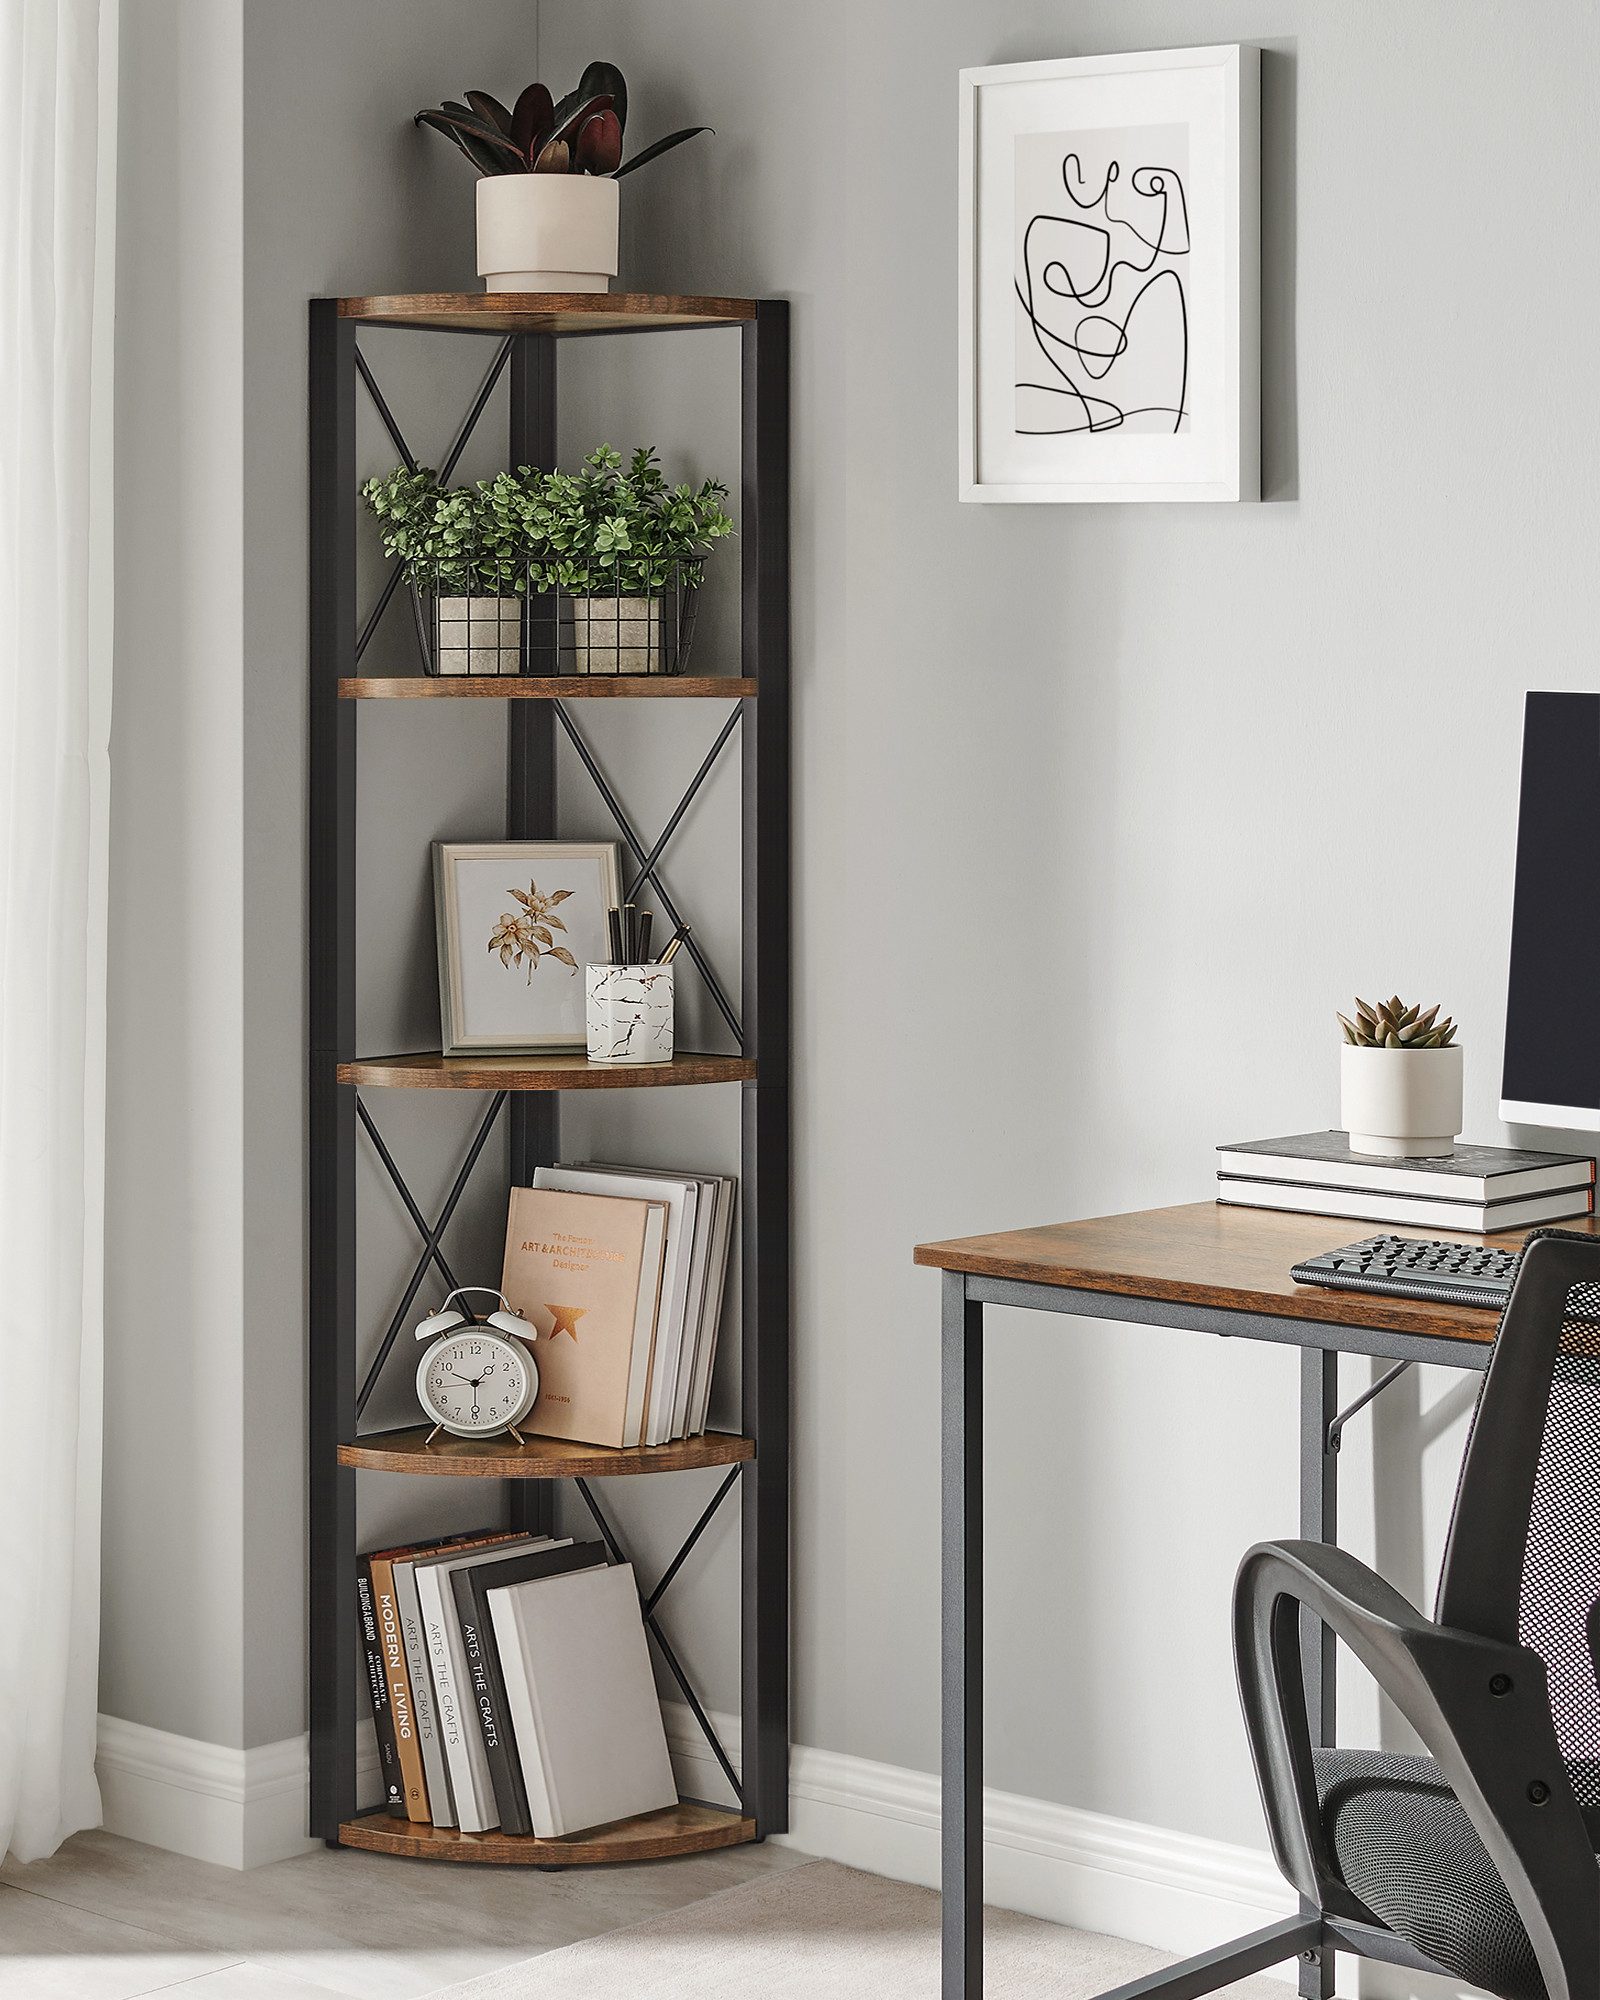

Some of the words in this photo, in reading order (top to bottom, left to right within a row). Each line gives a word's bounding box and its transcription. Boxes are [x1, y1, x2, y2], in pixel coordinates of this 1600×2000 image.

[521, 1242, 539, 1252] ART
[454, 1351, 463, 1359] 11
[471, 1346, 482, 1355] 12
[492, 1351, 496, 1359] 1
[442, 1362, 453, 1371] 10
[503, 1363, 510, 1371] 2
[436, 1378, 443, 1388] 9
[509, 1379, 516, 1387] 3
[441, 1395, 448, 1404] 8
[455, 1408, 461, 1416] 7
[490, 1408, 497, 1416] 5
[503, 1396, 509, 1404] 4
[357, 1578, 371, 1610] BUILDING
[363, 1616, 376, 1641] BRAND
[405, 1617, 419, 1651] ARTS
[430, 1622, 444, 1656] ARTS
[464, 1624, 480, 1658] ARTS
[380, 1594, 401, 1668] MODERN
[393, 1683, 412, 1739] LIVING
[412, 1657, 424, 1683] THE
[437, 1662, 450, 1688] THE
[472, 1662, 488, 1692] THE
[375, 1655, 388, 1704] CORPORATE
[417, 1689, 433, 1739] CRAFTS
[442, 1694, 460, 1745] CRAFTS
[479, 1696, 499, 1747] CRAFTS
